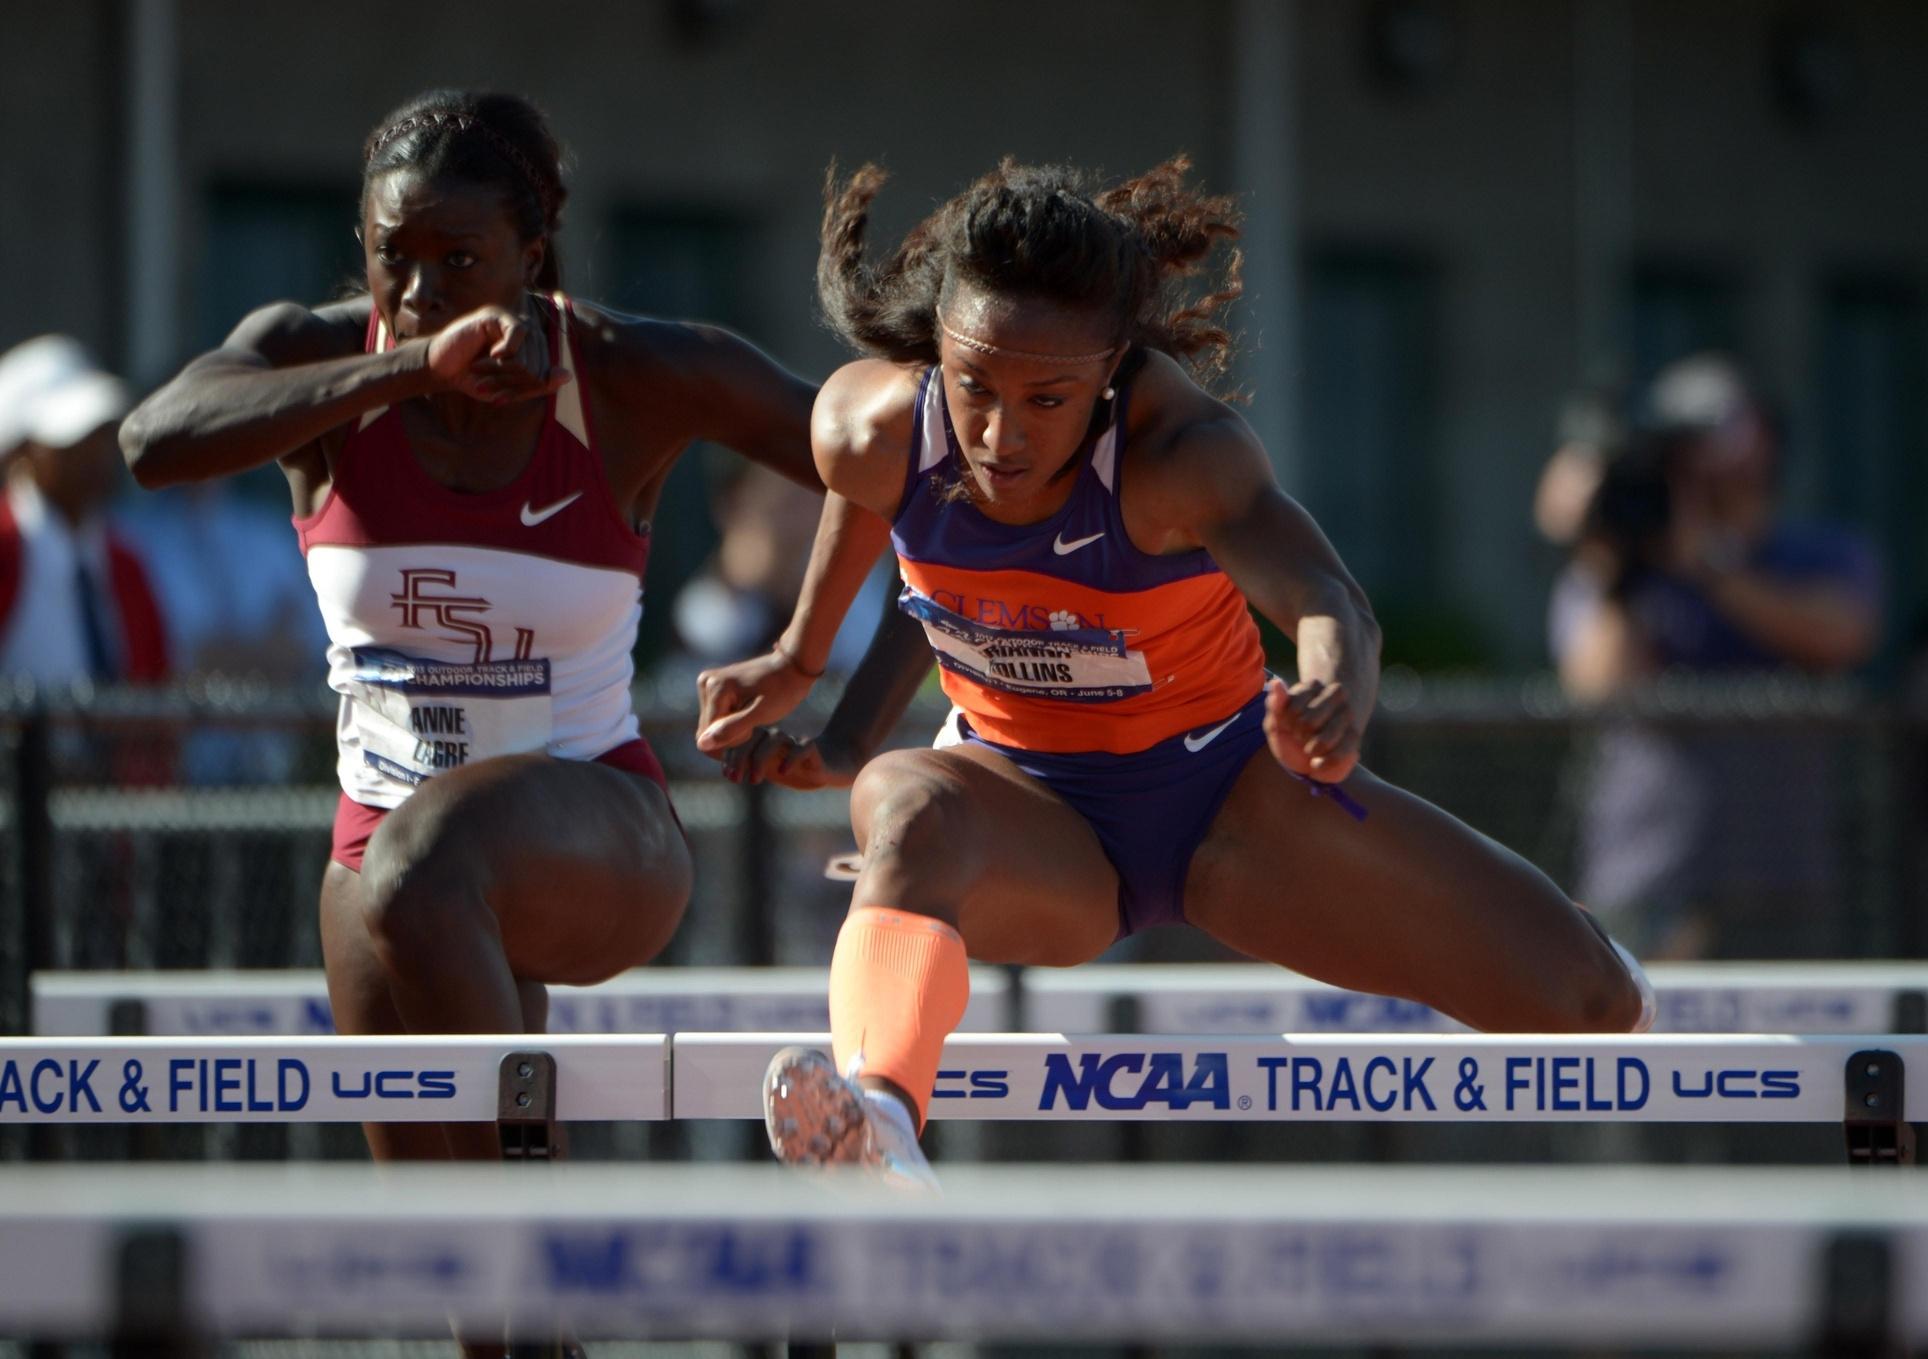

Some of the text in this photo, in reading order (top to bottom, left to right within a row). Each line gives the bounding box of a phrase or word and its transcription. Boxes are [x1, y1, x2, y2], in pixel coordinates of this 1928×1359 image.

[931, 589, 1105, 632] CLEMSN
[428, 665, 474, 674] OUTDOOR
[476, 664, 508, 674] TRACK
[517, 663, 544, 672] FIELD
[991, 661, 1074, 684] OLLINS
[1077, 688, 1105, 697] June
[411, 706, 466, 735] ANNE
[118, 1058, 151, 1113] &
[168, 1058, 311, 1112] FIELD
[331, 1071, 457, 1099] UCS
[931, 1052, 1801, 1111] CS NCAA TRACK & FIELD UCS
